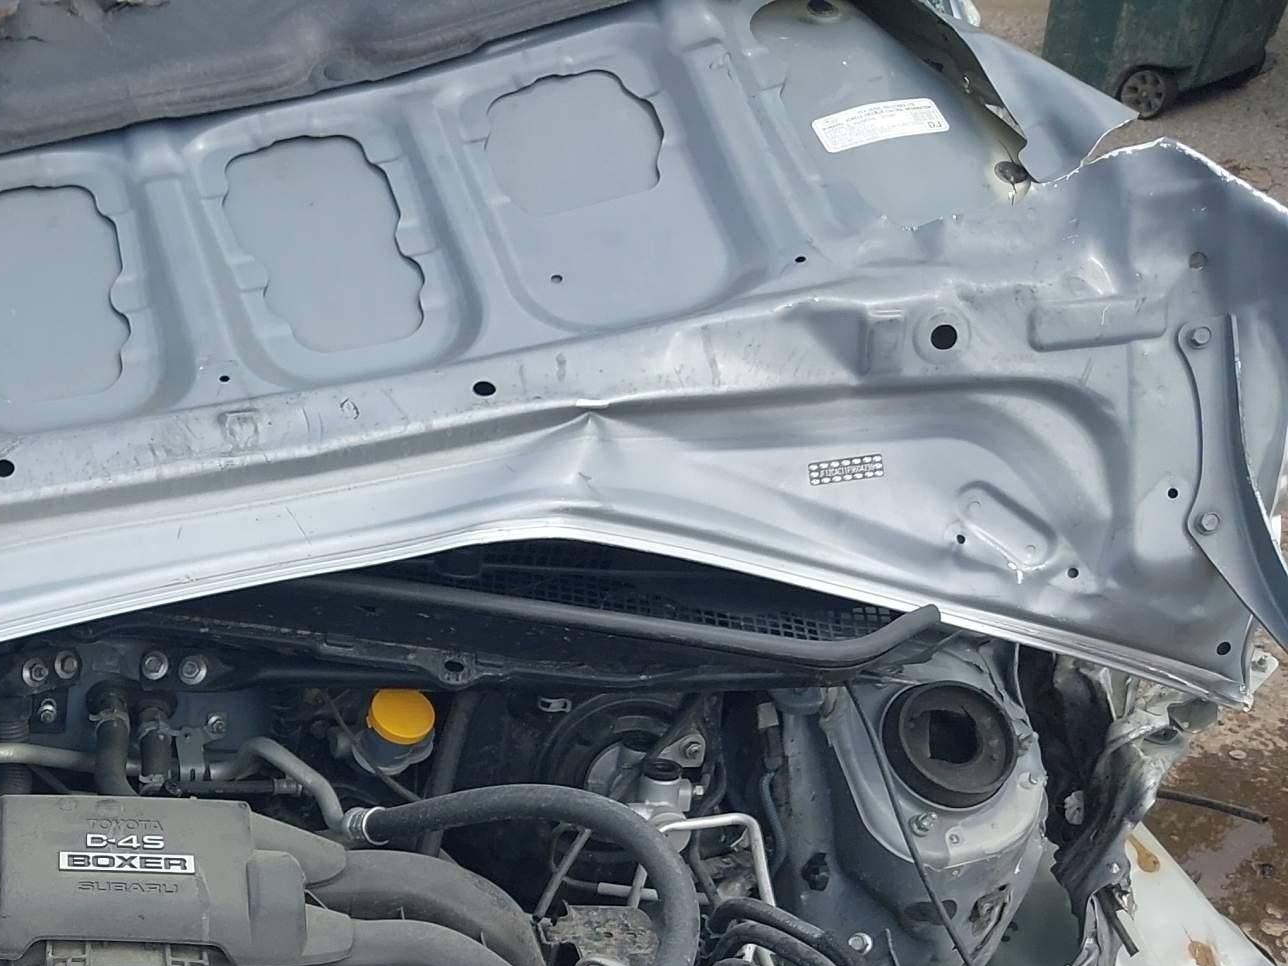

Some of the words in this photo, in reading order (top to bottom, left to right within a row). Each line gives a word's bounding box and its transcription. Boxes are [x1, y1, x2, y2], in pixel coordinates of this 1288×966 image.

[87, 818, 165, 831] TOYOTA
[85, 833, 165, 851] D-4S
[67, 854, 188, 871] BOXER
[77, 880, 179, 894] SUBARU
